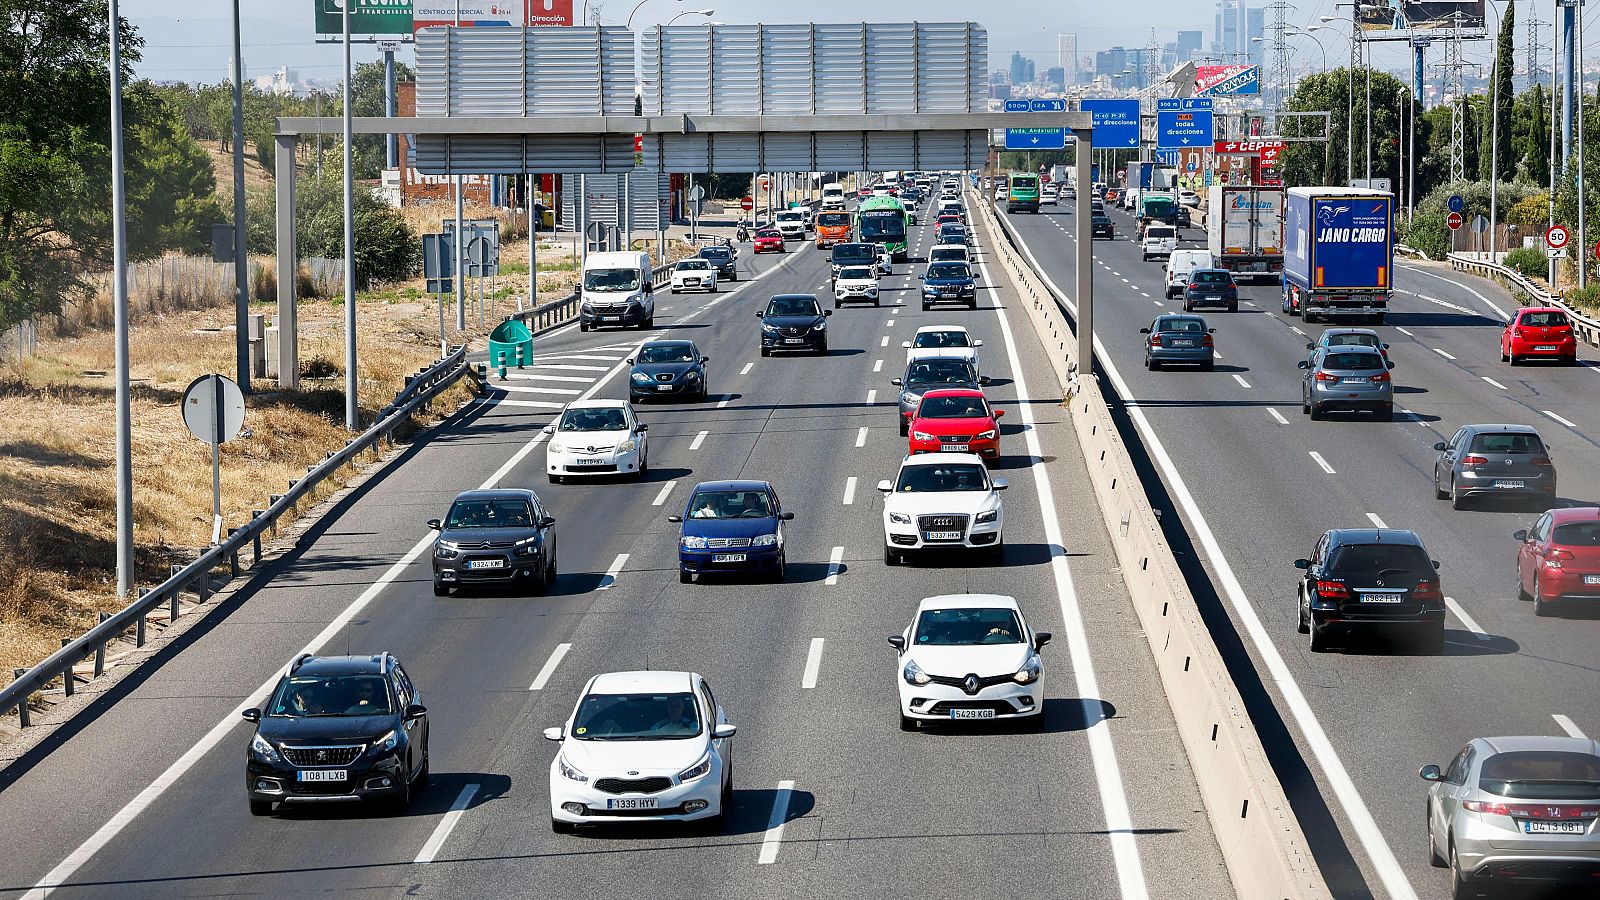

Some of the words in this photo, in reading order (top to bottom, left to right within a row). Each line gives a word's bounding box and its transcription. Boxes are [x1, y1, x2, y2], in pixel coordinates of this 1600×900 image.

[531, 14, 565, 22] Dirección
[1317, 227, 1351, 243] JANO
[1351, 227, 1386, 243] CARGO
[1551, 233, 1564, 241] 50
[955, 709, 976, 719] 5429
[977, 709, 993, 718] KGB
[304, 771, 326, 780] 1081
[328, 770, 346, 779] LXB
[616, 800, 636, 808] 1339
[639, 799, 655, 808] HYV
[1532, 822, 1558, 831] 0413
[1561, 822, 1580, 832] GBT
